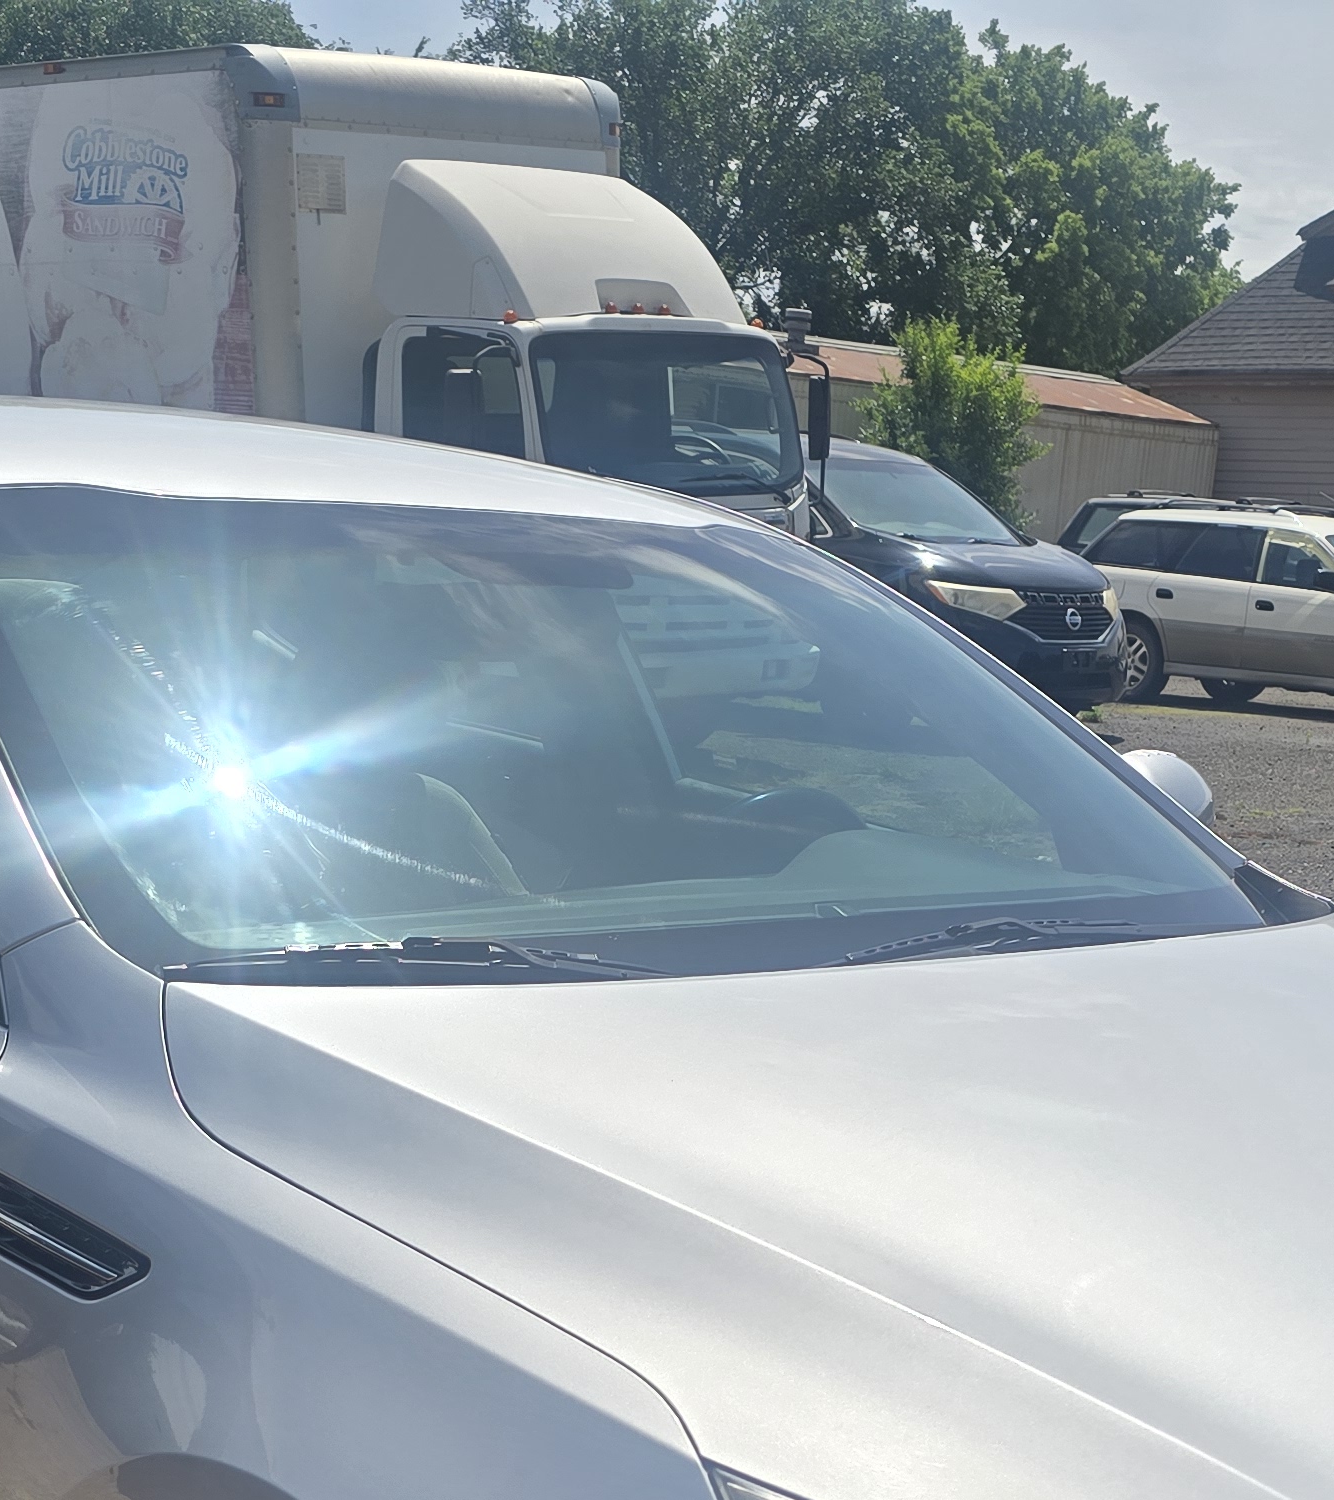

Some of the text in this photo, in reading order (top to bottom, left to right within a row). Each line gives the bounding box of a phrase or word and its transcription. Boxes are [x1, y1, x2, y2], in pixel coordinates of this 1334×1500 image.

[64, 126, 187, 177] Cobblestone
[75, 165, 122, 201] Mill
[72, 210, 168, 239] SANDWICH
